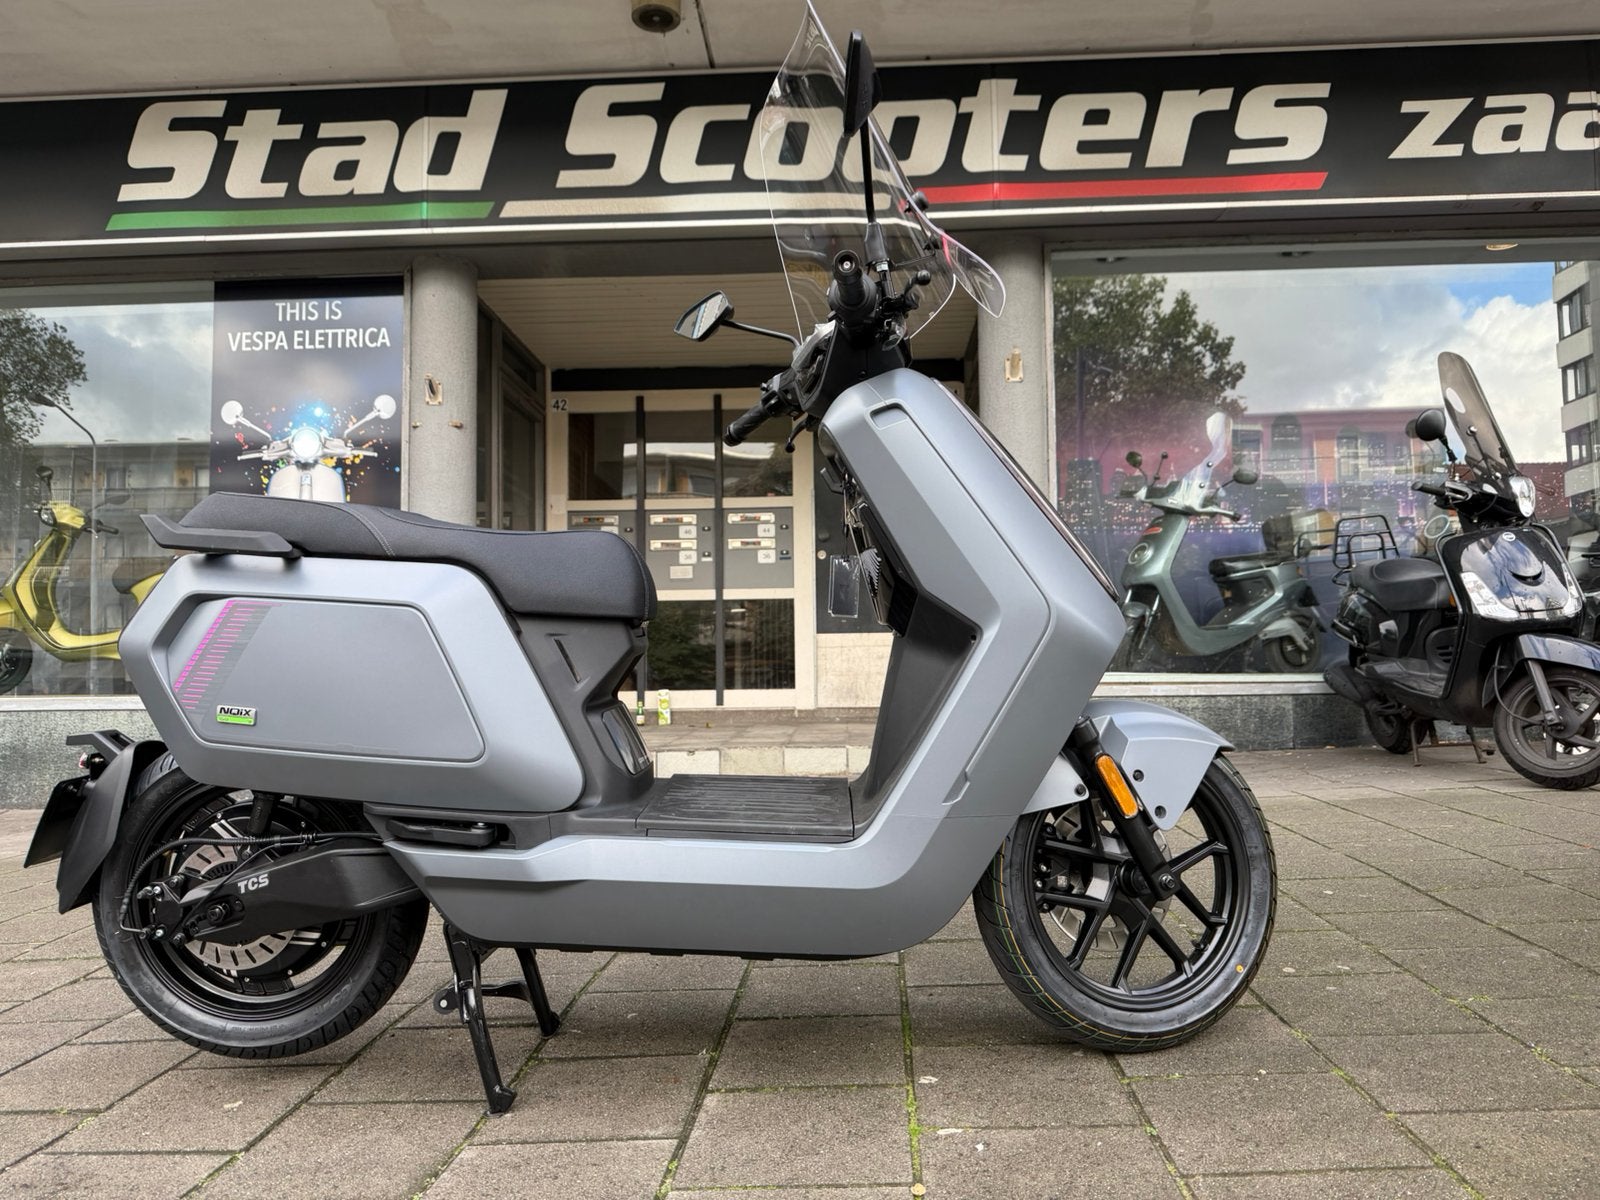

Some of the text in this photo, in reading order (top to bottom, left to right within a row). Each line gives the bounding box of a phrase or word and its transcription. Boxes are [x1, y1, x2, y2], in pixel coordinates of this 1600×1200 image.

[117, 88, 508, 202] Stad
[556, 79, 1332, 188] Scooters
[275, 300, 342, 322] THIS IS
[227, 327, 391, 351] VESPA ELETTRICA
[552, 399, 567, 411] 42
[237, 873, 269, 894] TCS
